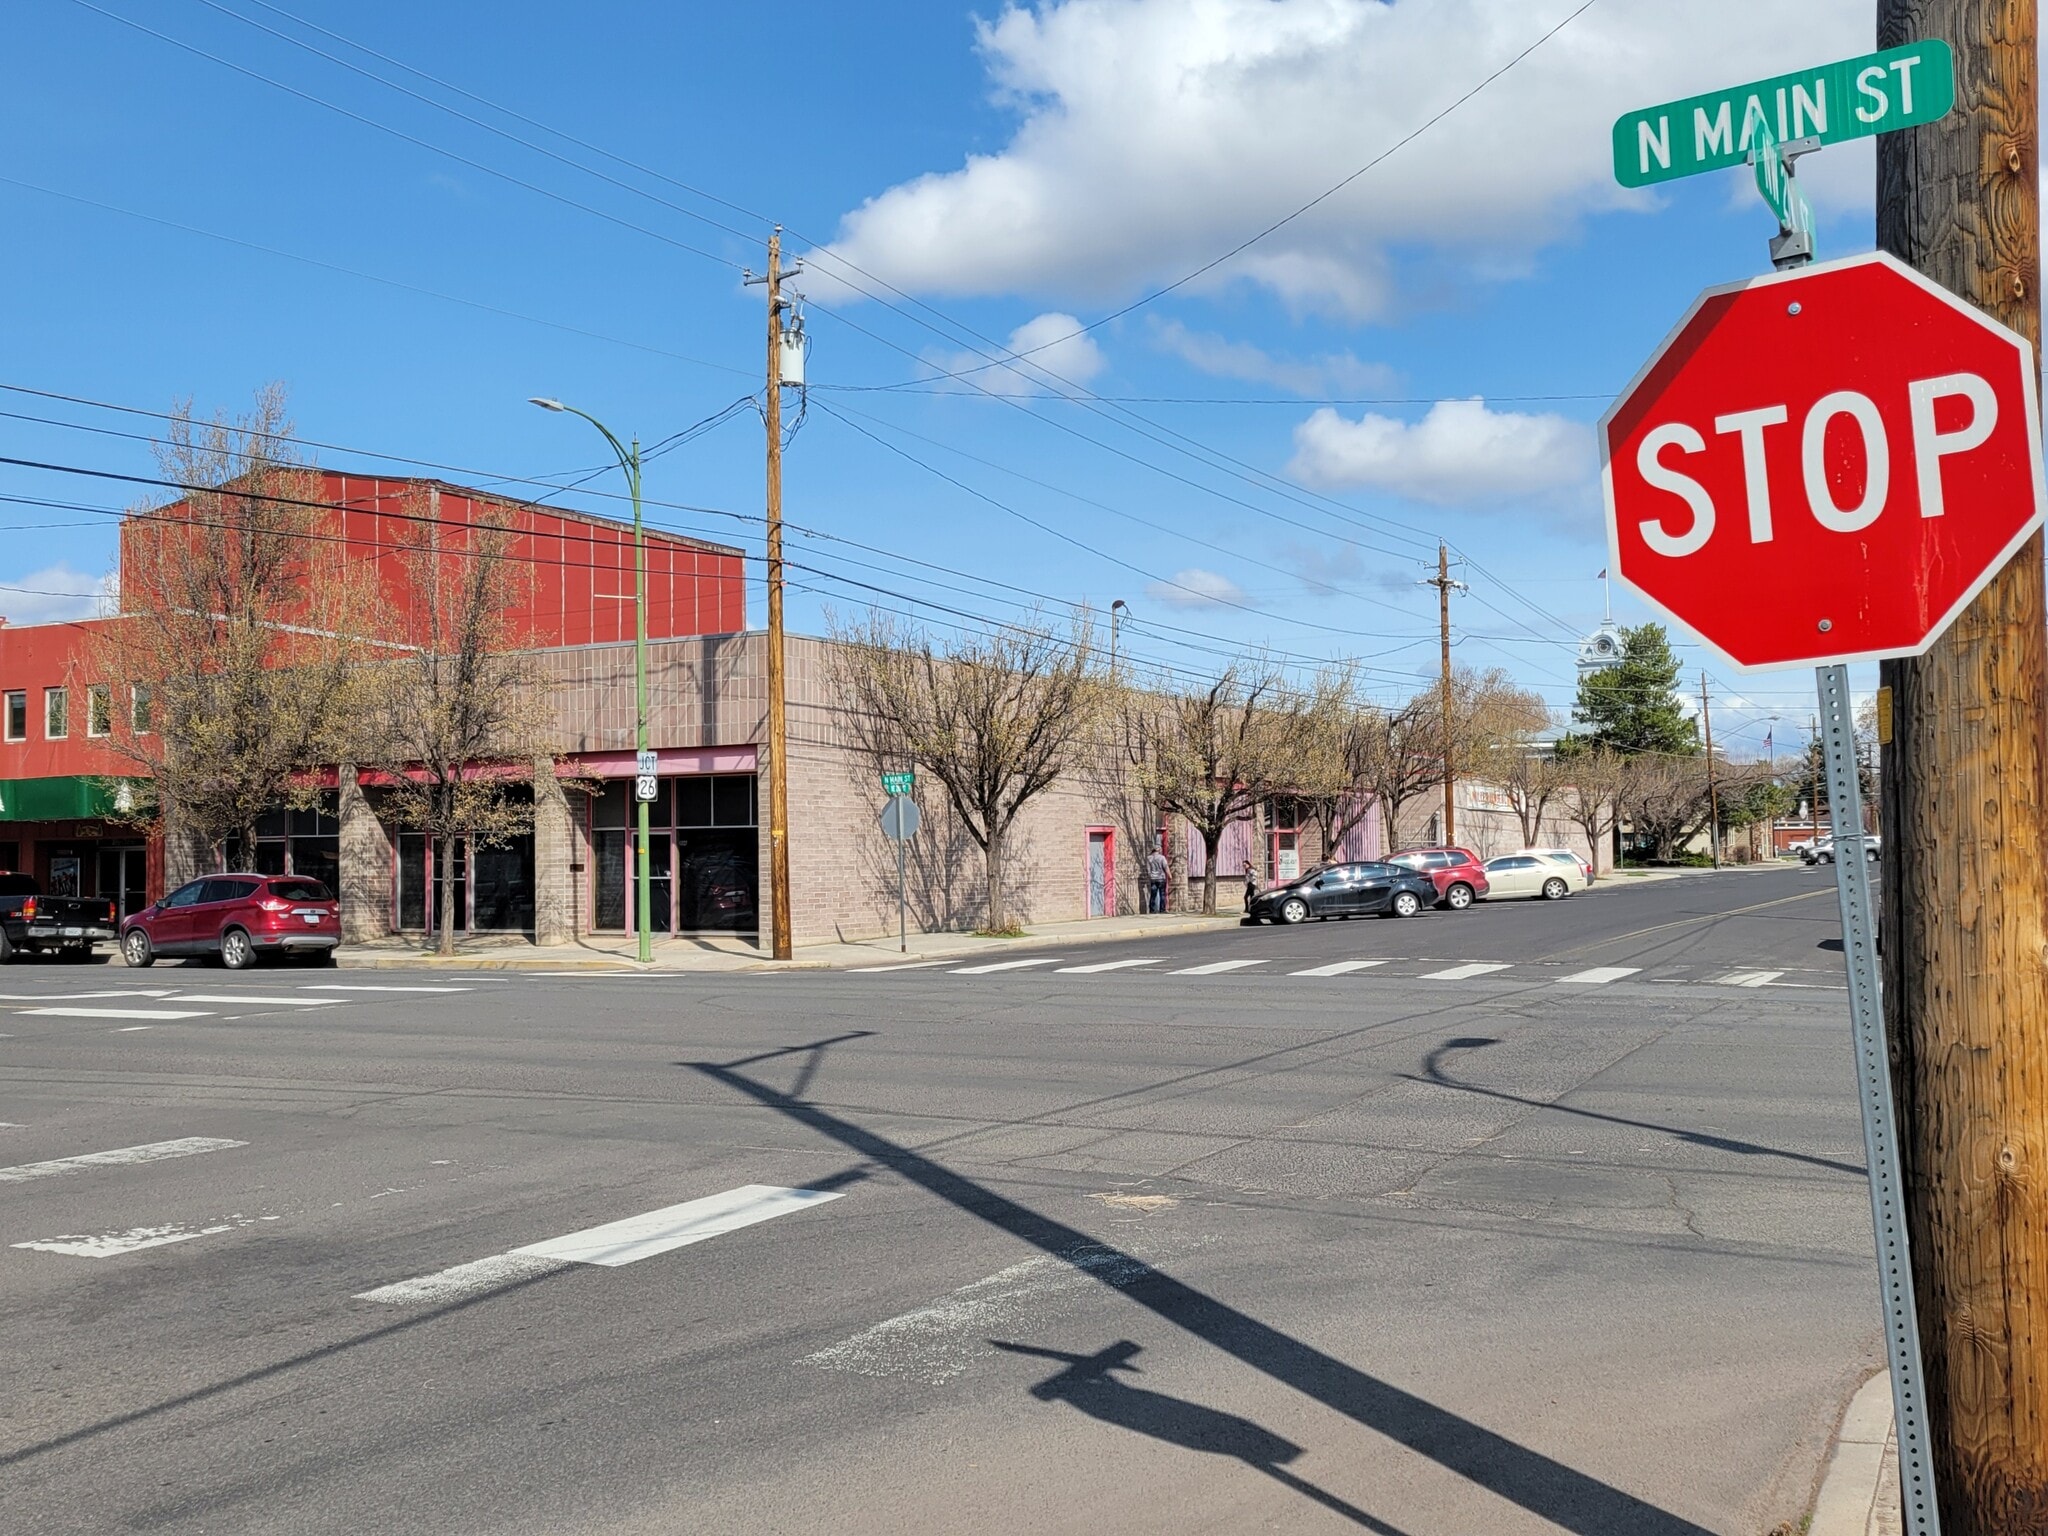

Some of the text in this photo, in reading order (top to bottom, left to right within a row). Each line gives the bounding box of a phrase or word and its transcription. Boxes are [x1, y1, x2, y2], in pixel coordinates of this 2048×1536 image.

[1638, 56, 1921, 174] N MAIN ST
[1636, 372, 1999, 558] STOP
[640, 755, 656, 770] JCT
[904, 774, 911, 783] ST
[640, 779, 655, 796] 26
